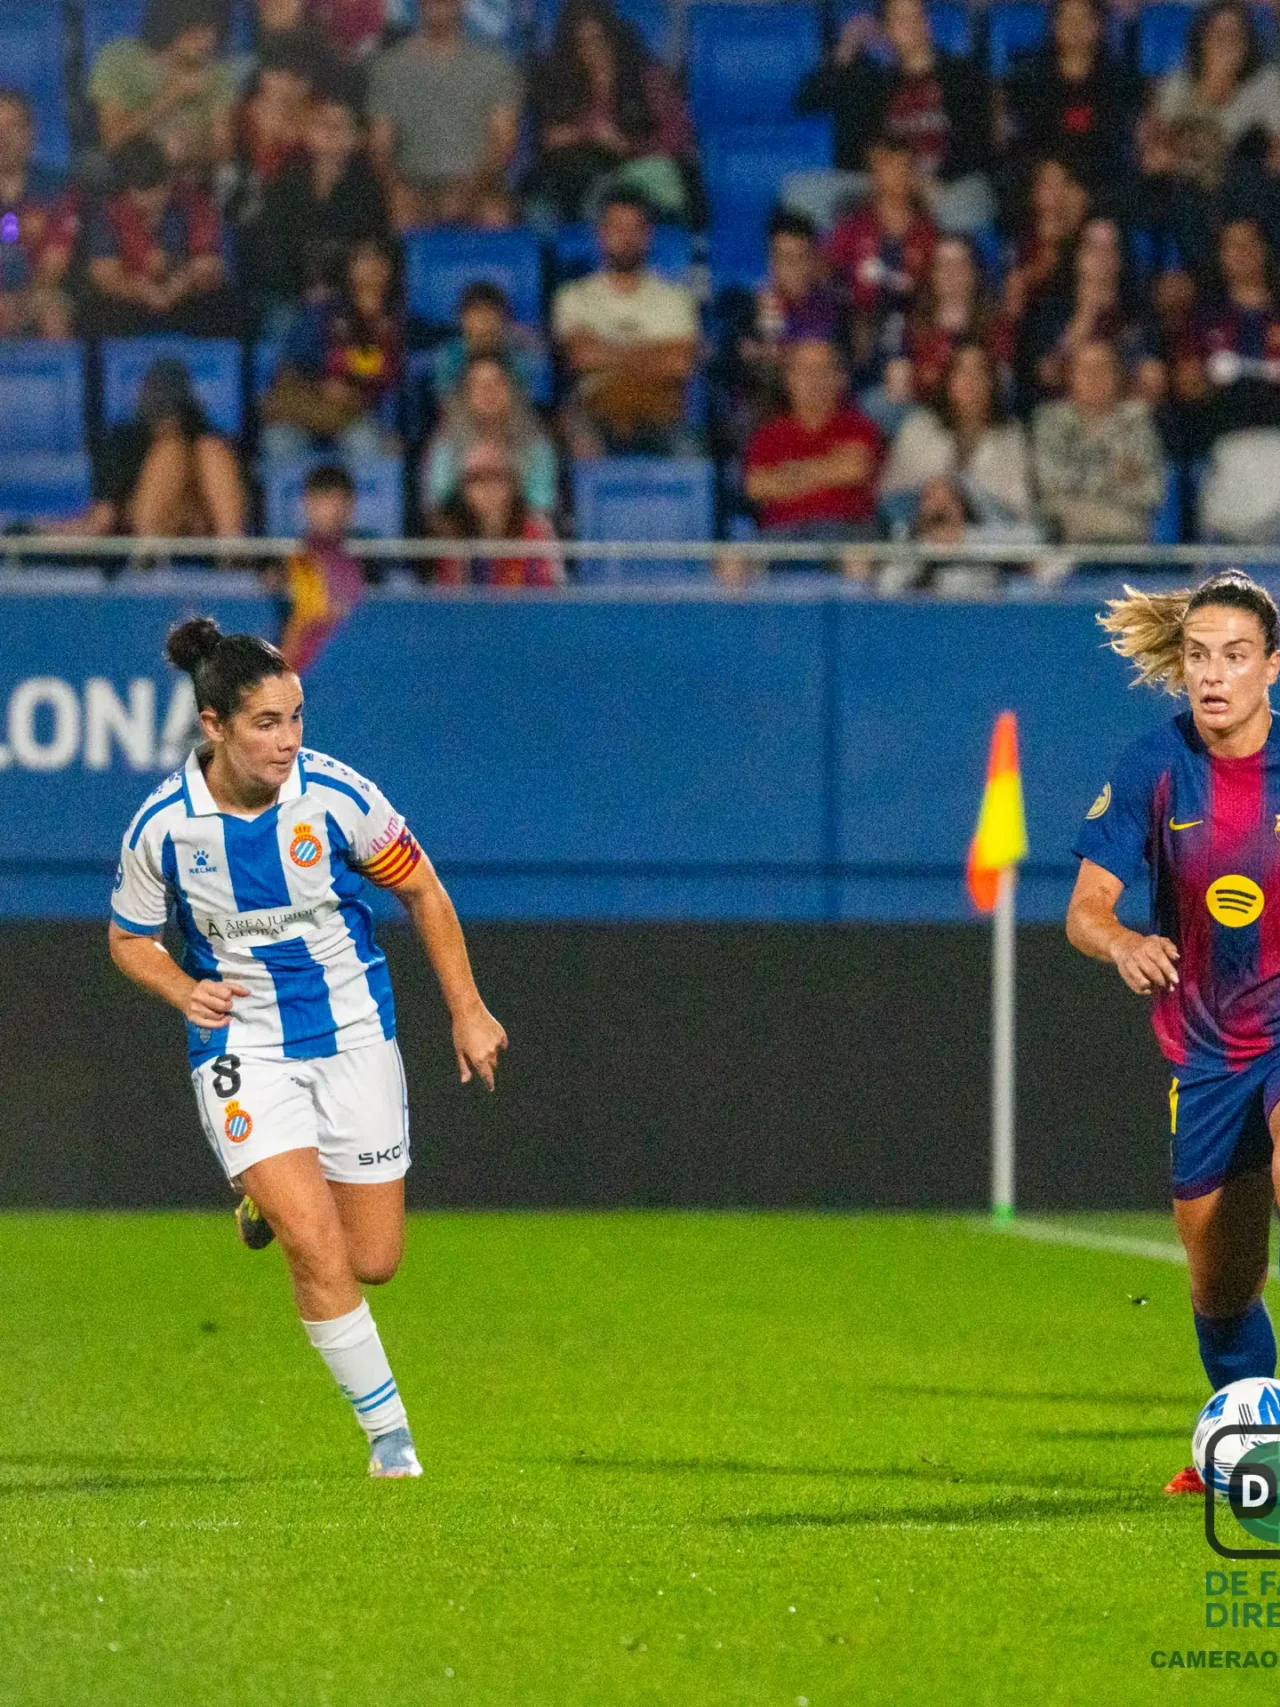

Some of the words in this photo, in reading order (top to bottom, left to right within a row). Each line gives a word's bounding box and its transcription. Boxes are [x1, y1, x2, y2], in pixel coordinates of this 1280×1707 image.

[189, 866, 217, 874] KELME
[228, 925, 288, 940] GLOBAL
[211, 1053, 242, 1098] 8
